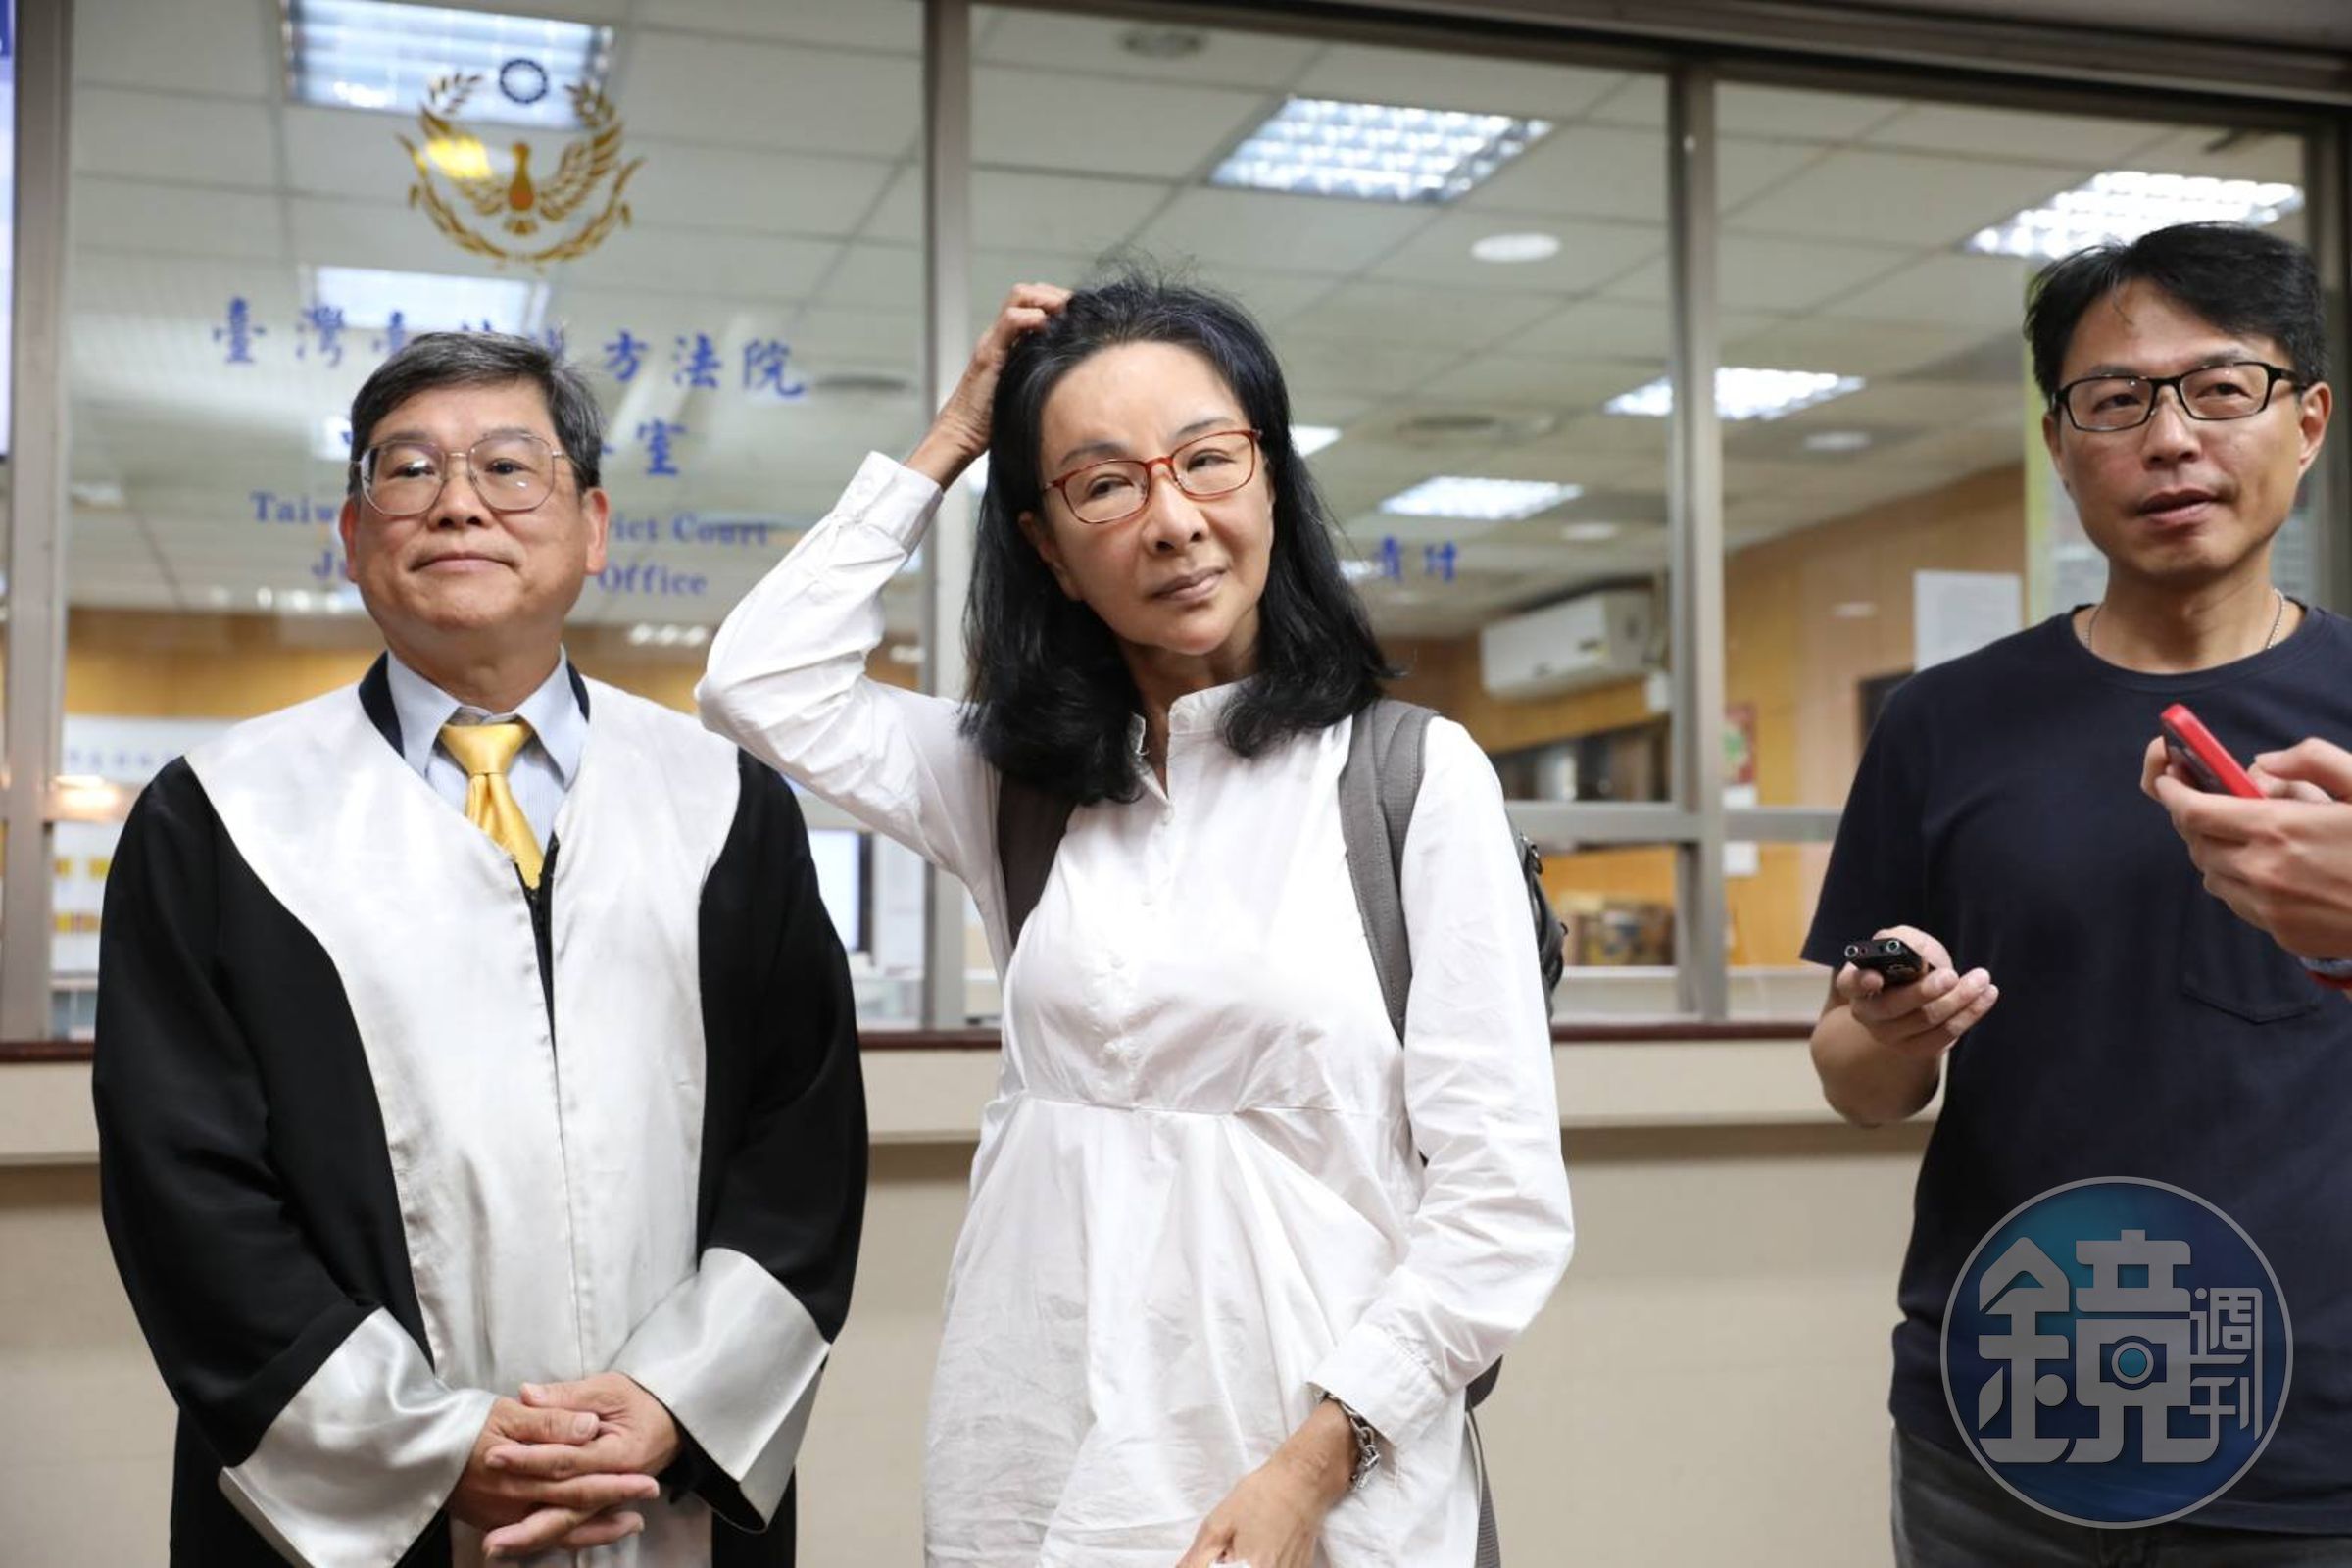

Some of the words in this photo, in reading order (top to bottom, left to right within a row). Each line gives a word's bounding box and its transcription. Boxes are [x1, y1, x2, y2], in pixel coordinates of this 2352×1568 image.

[251, 491, 336, 522] Taiw
[672, 510, 769, 546] Court
[596, 556, 708, 595] Office
